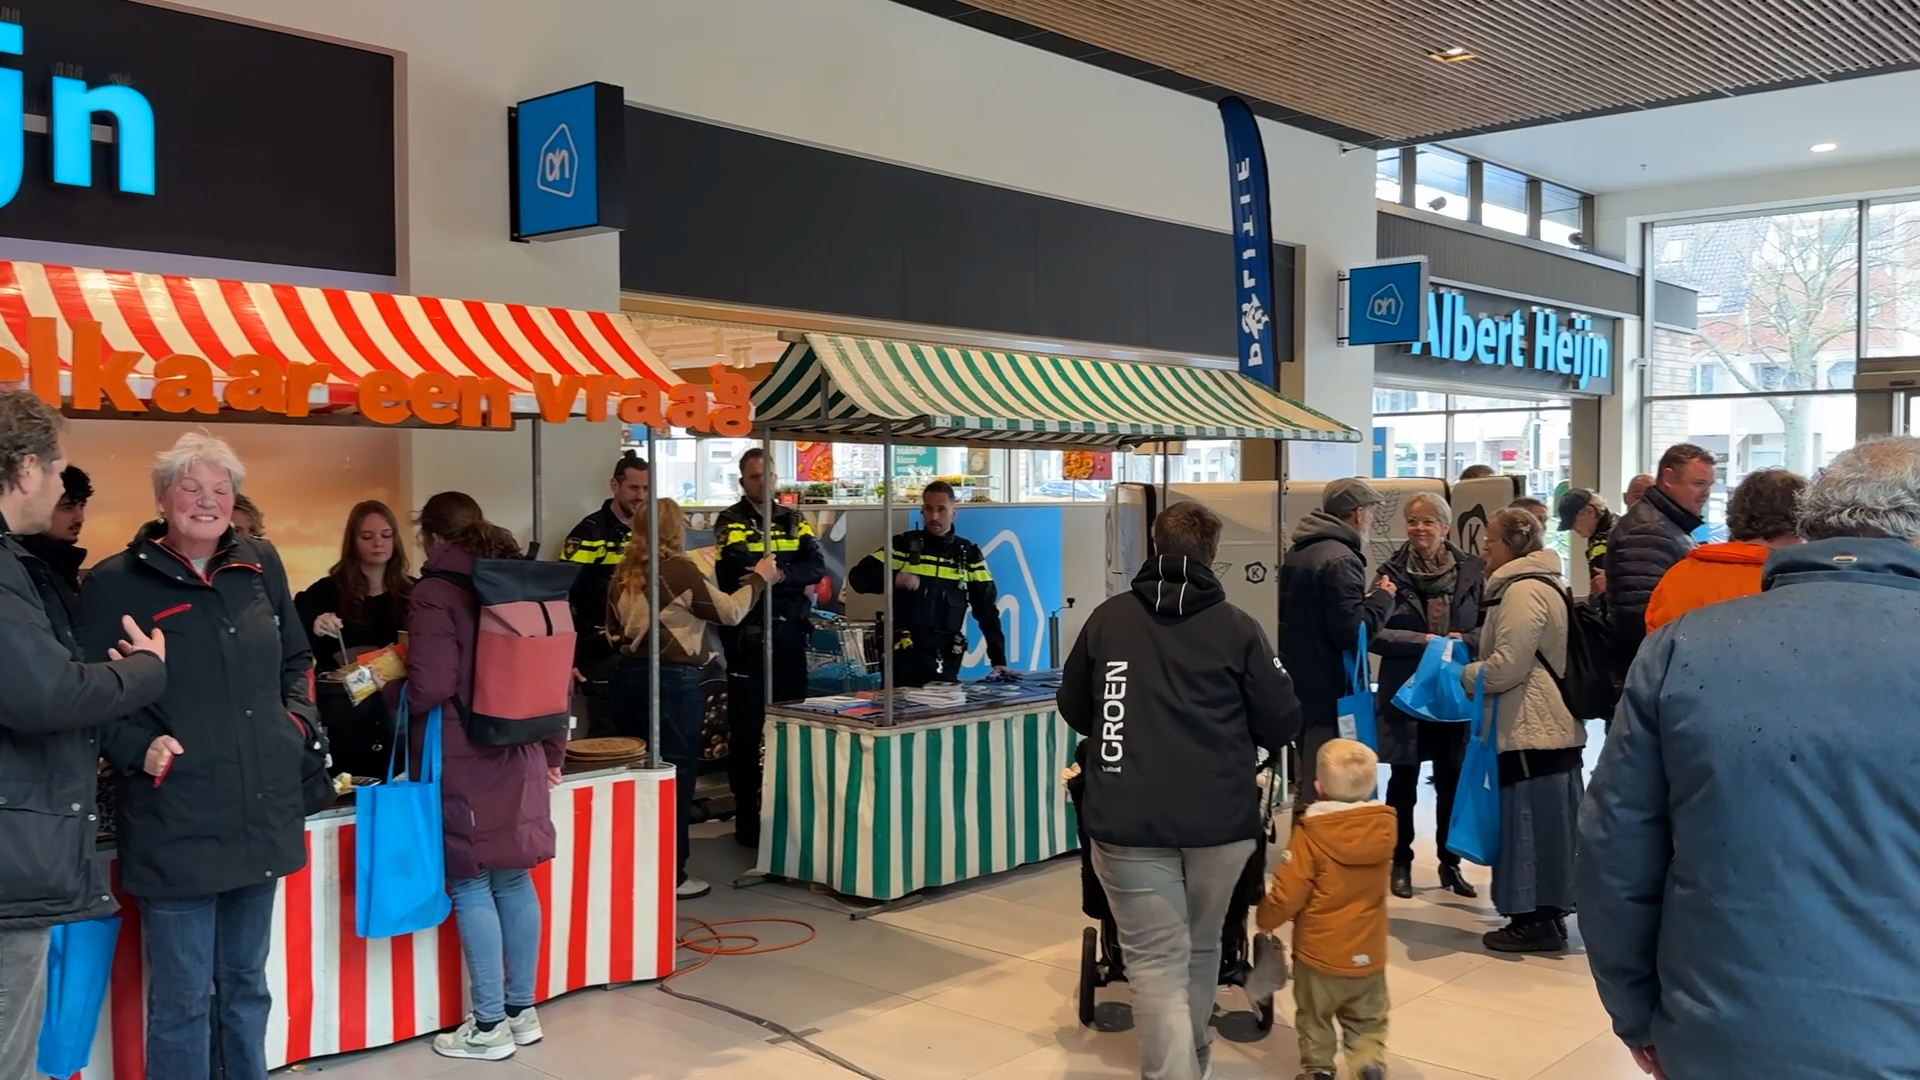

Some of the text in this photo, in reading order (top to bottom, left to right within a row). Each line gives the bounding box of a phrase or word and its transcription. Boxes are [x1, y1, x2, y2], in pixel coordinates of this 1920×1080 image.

[1534, 311, 1609, 390] Heijn
[359, 369, 513, 429] een
[530, 363, 754, 437] vraag
[1469, 523, 1481, 556] K
[1100, 661, 1128, 763] GROEN
